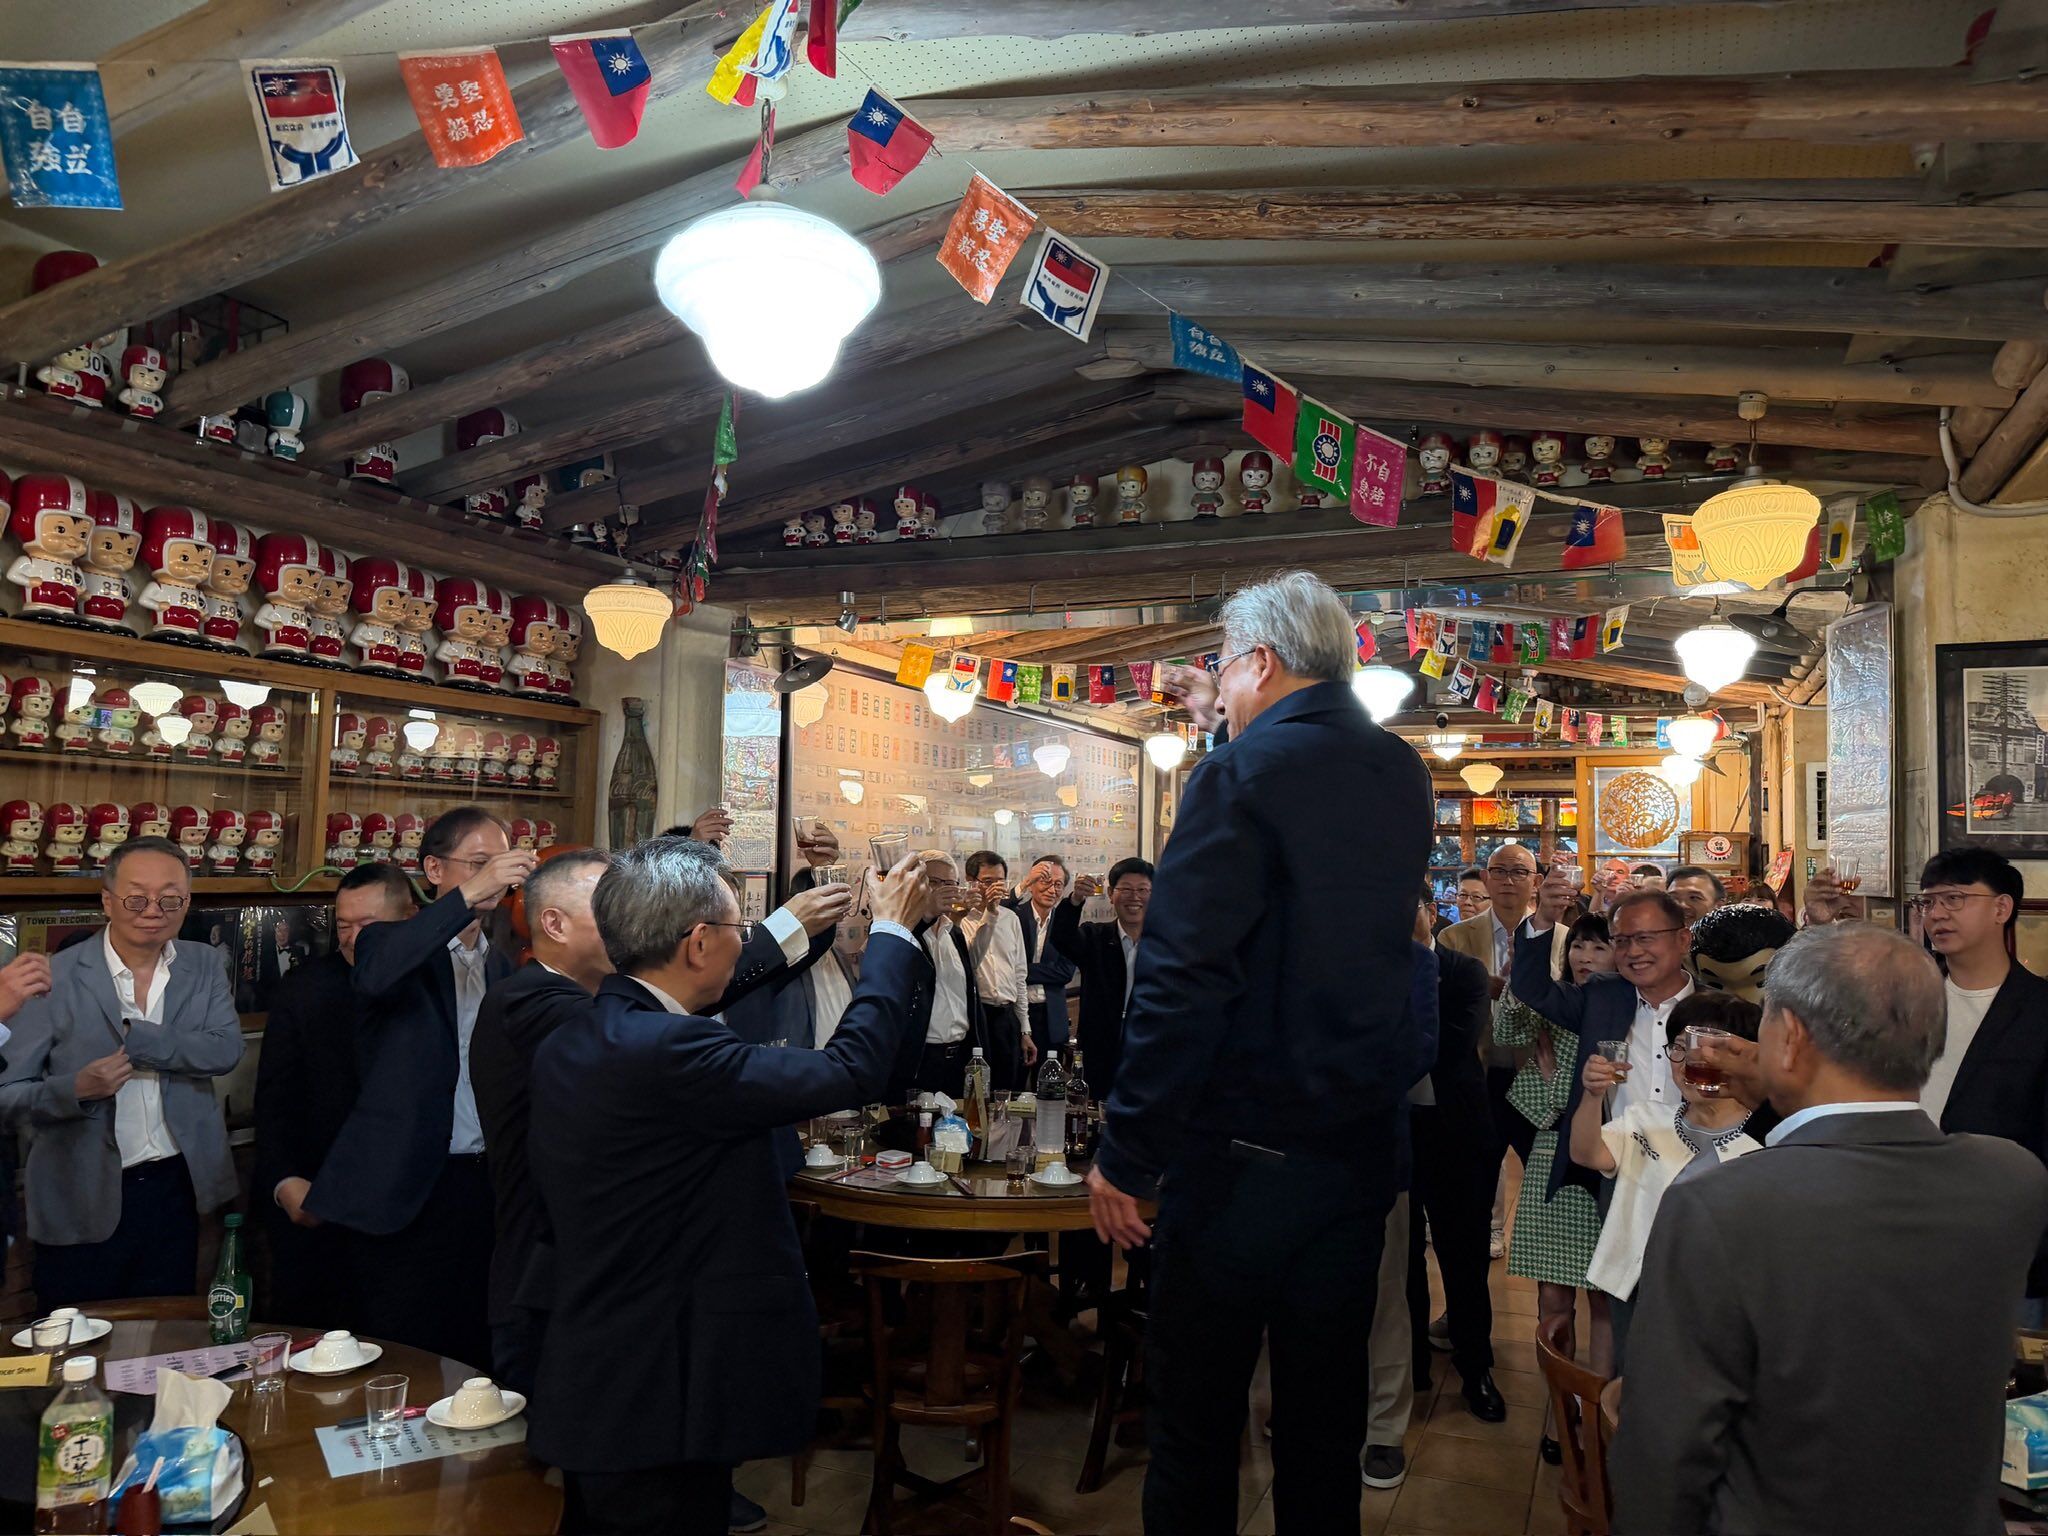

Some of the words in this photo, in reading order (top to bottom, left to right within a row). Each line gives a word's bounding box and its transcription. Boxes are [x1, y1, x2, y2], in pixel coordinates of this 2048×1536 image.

[54, 567, 72, 584] 86
[102, 581, 120, 595] 87
[219, 605, 236, 618] 89
[291, 612, 305, 625] 90
[26, 917, 57, 925] TOWER
[71, 1436, 91, 1481] 十六茶
